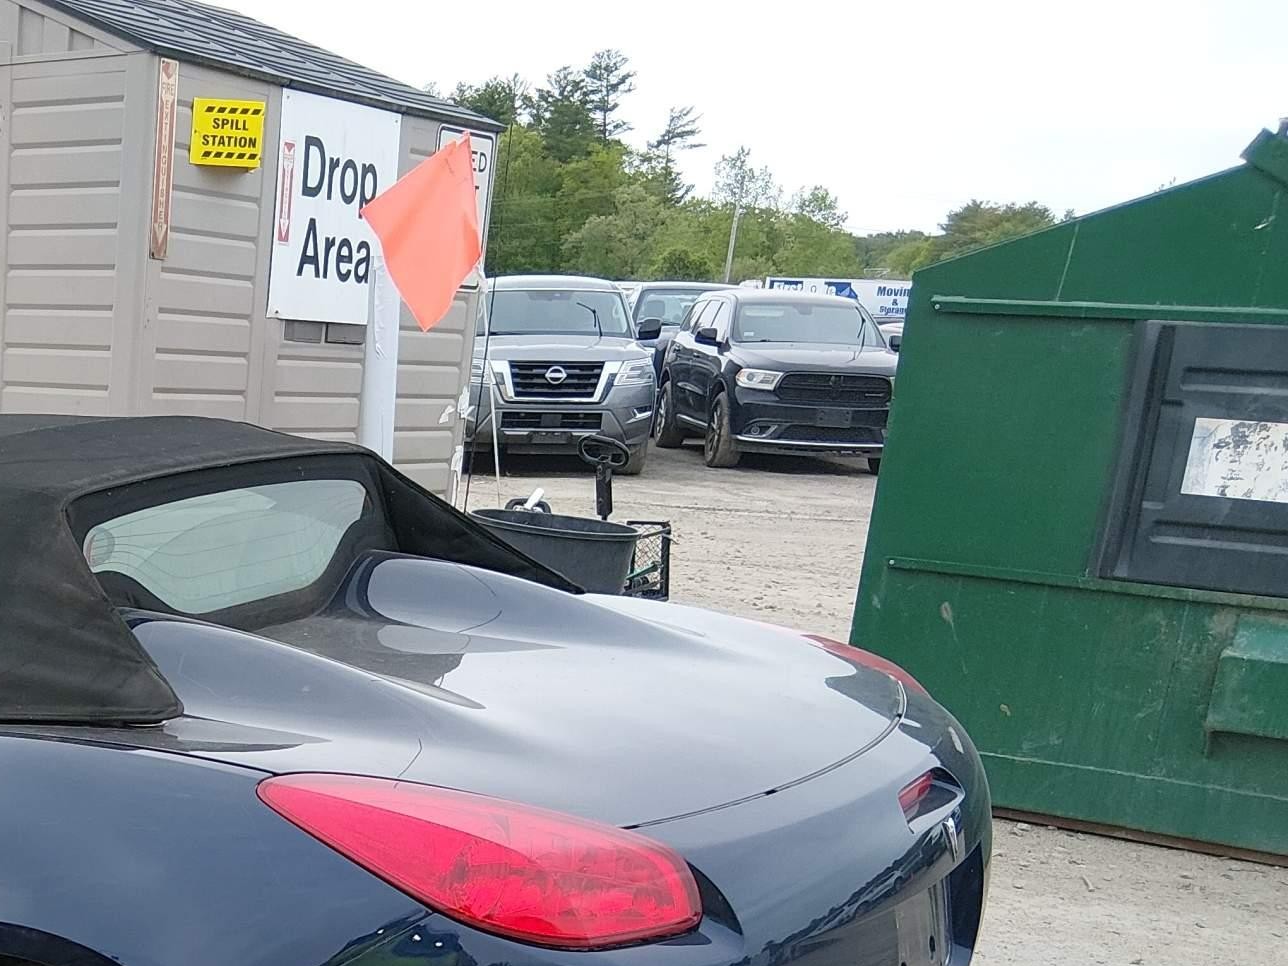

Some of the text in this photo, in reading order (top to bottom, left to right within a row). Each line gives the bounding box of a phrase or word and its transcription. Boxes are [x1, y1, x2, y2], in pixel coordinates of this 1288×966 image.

[212, 117, 249, 131] SPILL
[202, 134, 257, 148] STATION
[302, 135, 378, 219] Drop
[296, 217, 371, 284] Area
[876, 285, 911, 297] Movin
